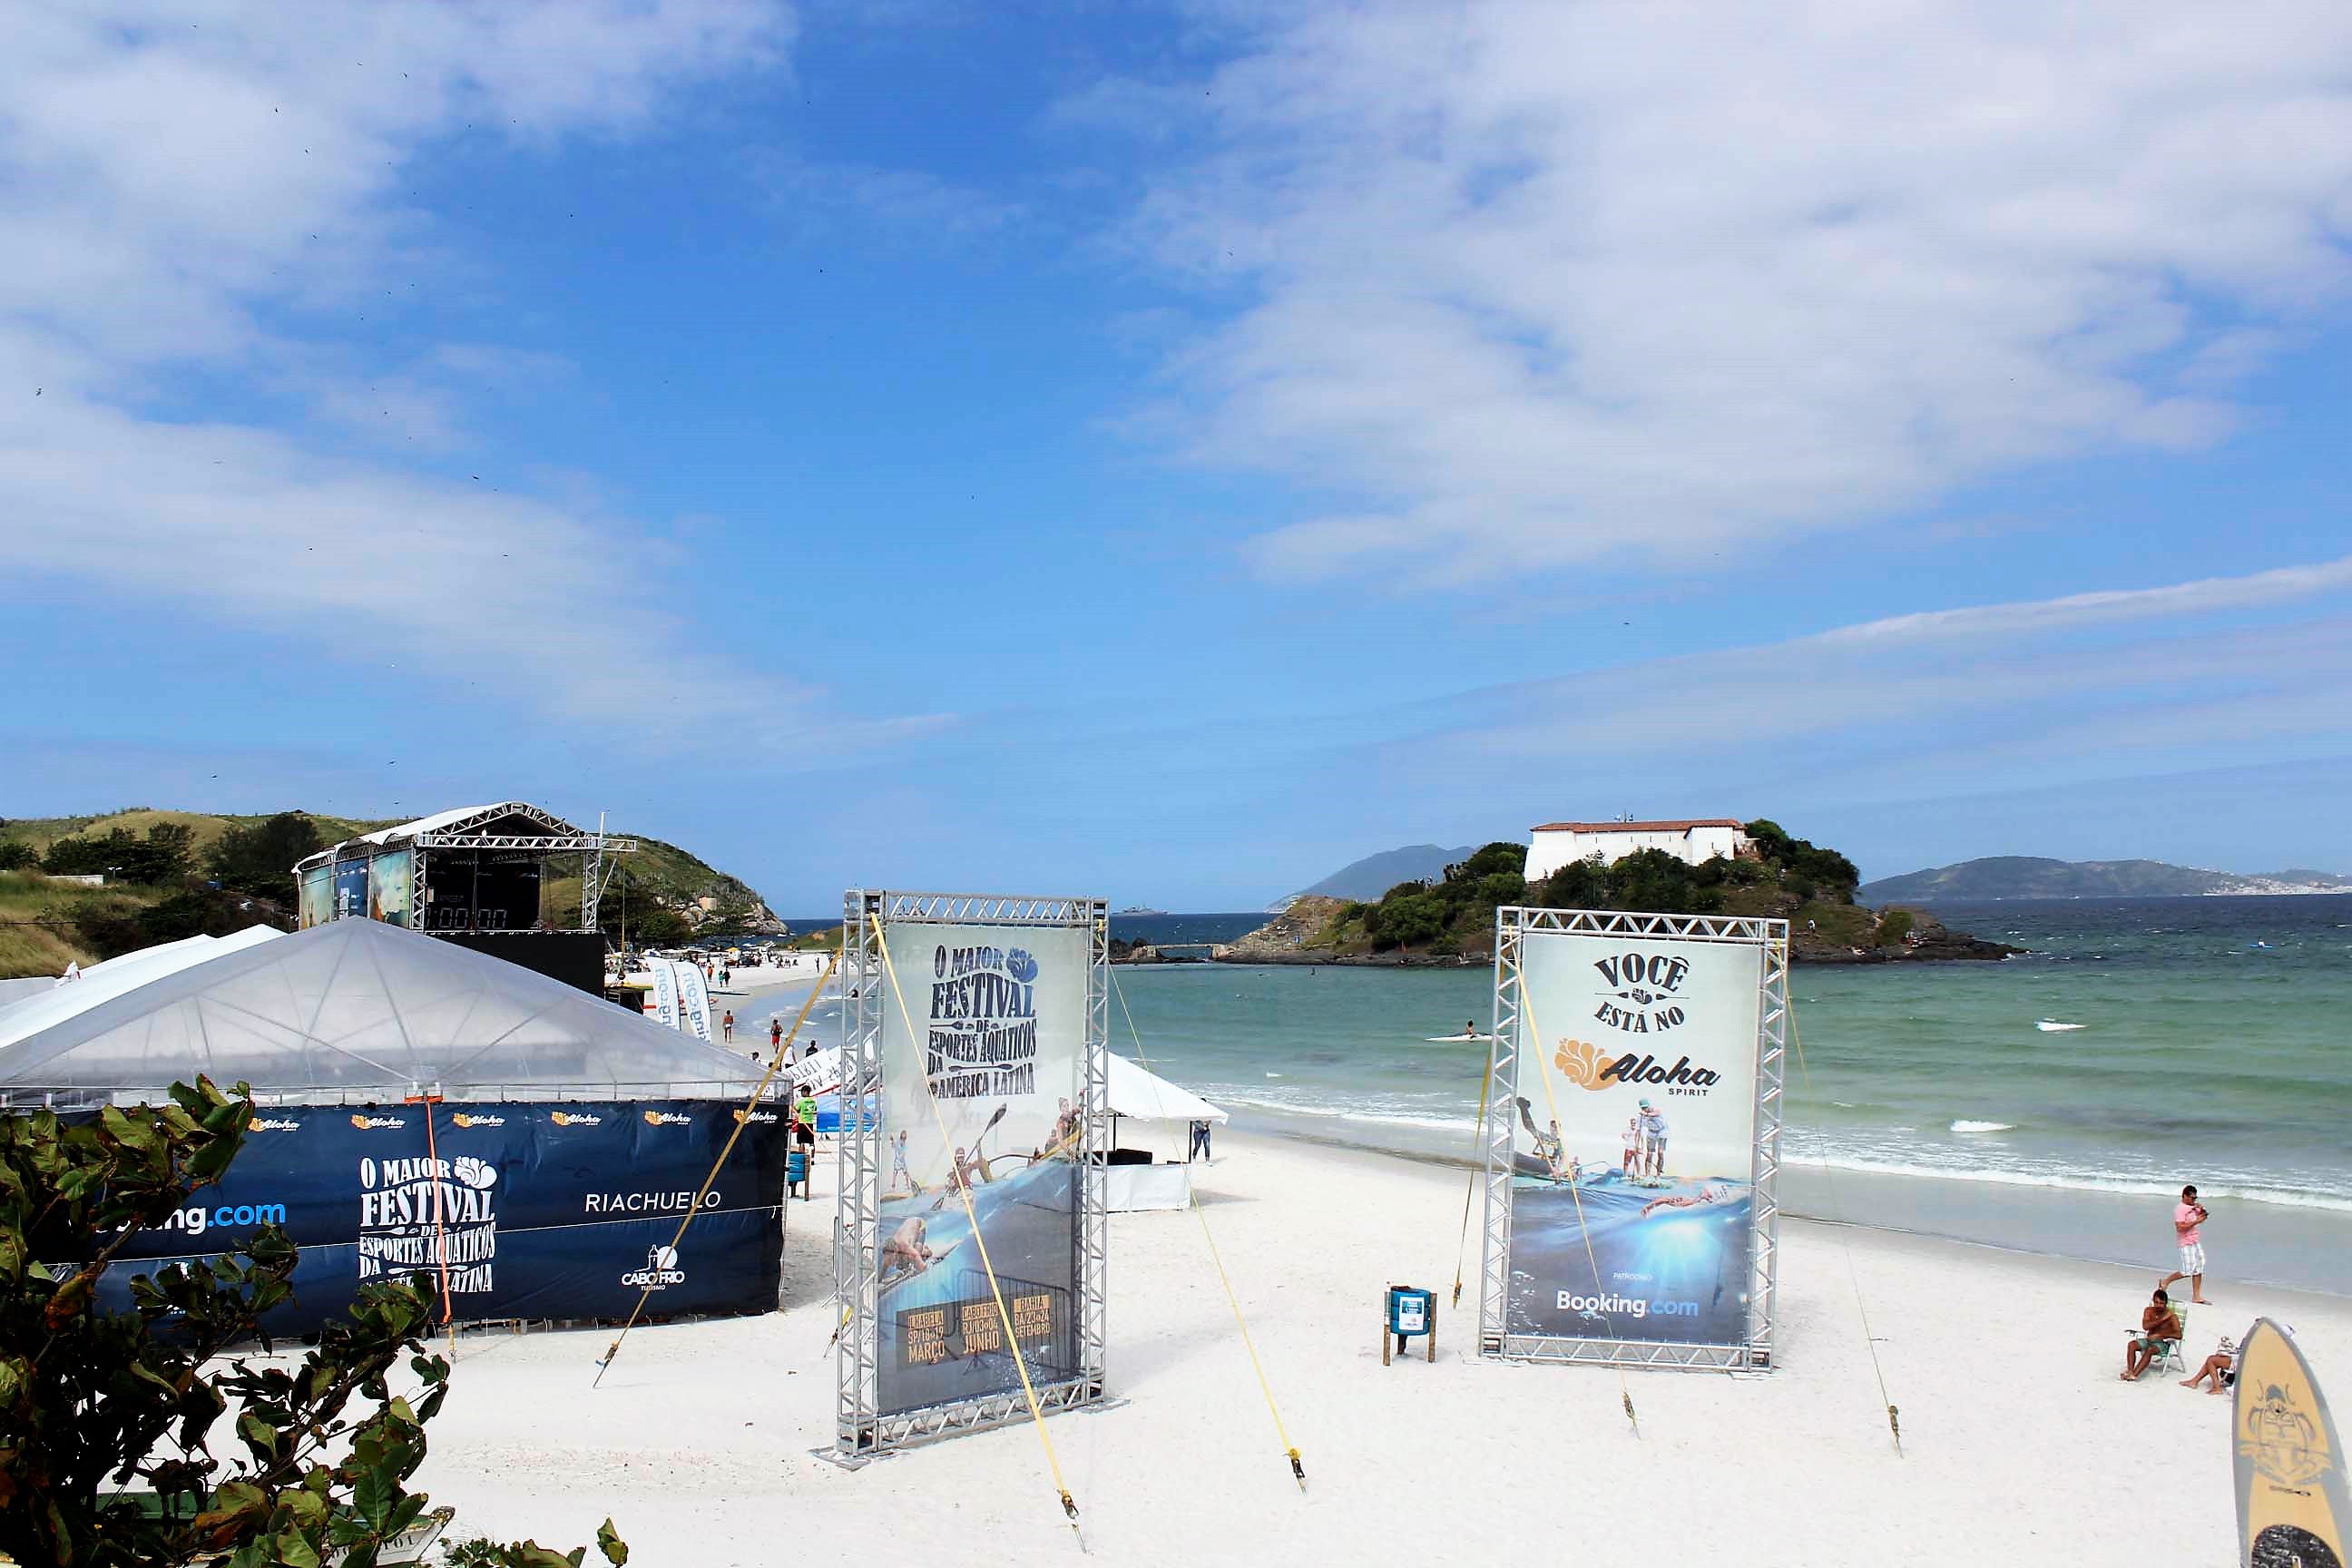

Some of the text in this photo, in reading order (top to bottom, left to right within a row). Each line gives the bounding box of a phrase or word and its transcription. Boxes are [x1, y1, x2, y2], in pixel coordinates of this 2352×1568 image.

[935, 945, 1004, 978] O MAIOR
[1594, 954, 1690, 992] VOCÊ
[930, 972, 1036, 1018] FESTIVAL
[975, 1019, 990, 1033] DE
[1593, 1002, 1685, 1033] ESTÁ NO
[928, 1018, 1037, 1064] ESPORTES AQUÁTICOS
[927, 1052, 944, 1075] DA
[1599, 1053, 1721, 1087] Aloha
[938, 1063, 1035, 1098] AMÉRICA LATINA
[1668, 1087, 1709, 1097] SPIRIT
[261, 1119, 300, 1129] Aloha
[367, 1116, 407, 1127] Aloha
[471, 1114, 505, 1124] Aloha
[566, 1113, 602, 1123] Aloha
[661, 1112, 691, 1122] Aloha
[746, 1111, 779, 1122] Aloha
[360, 1157, 452, 1190] O MAIOR
[360, 1181, 495, 1227] FESTIVAL
[584, 1191, 722, 1213] RIACHUELO
[420, 1225, 439, 1237] DE
[359, 1236, 424, 1265] ESPORTES
[358, 1255, 382, 1279] DA
[622, 1270, 685, 1286] CABO FRIO
[1020, 1296, 1044, 1312] BAHIA
[1556, 1289, 1700, 1318] Booking.com
[1014, 1322, 1051, 1338] SETEMBRO
[908, 1339, 945, 1365] MARÇO
[963, 1330, 999, 1354] JUNHO
